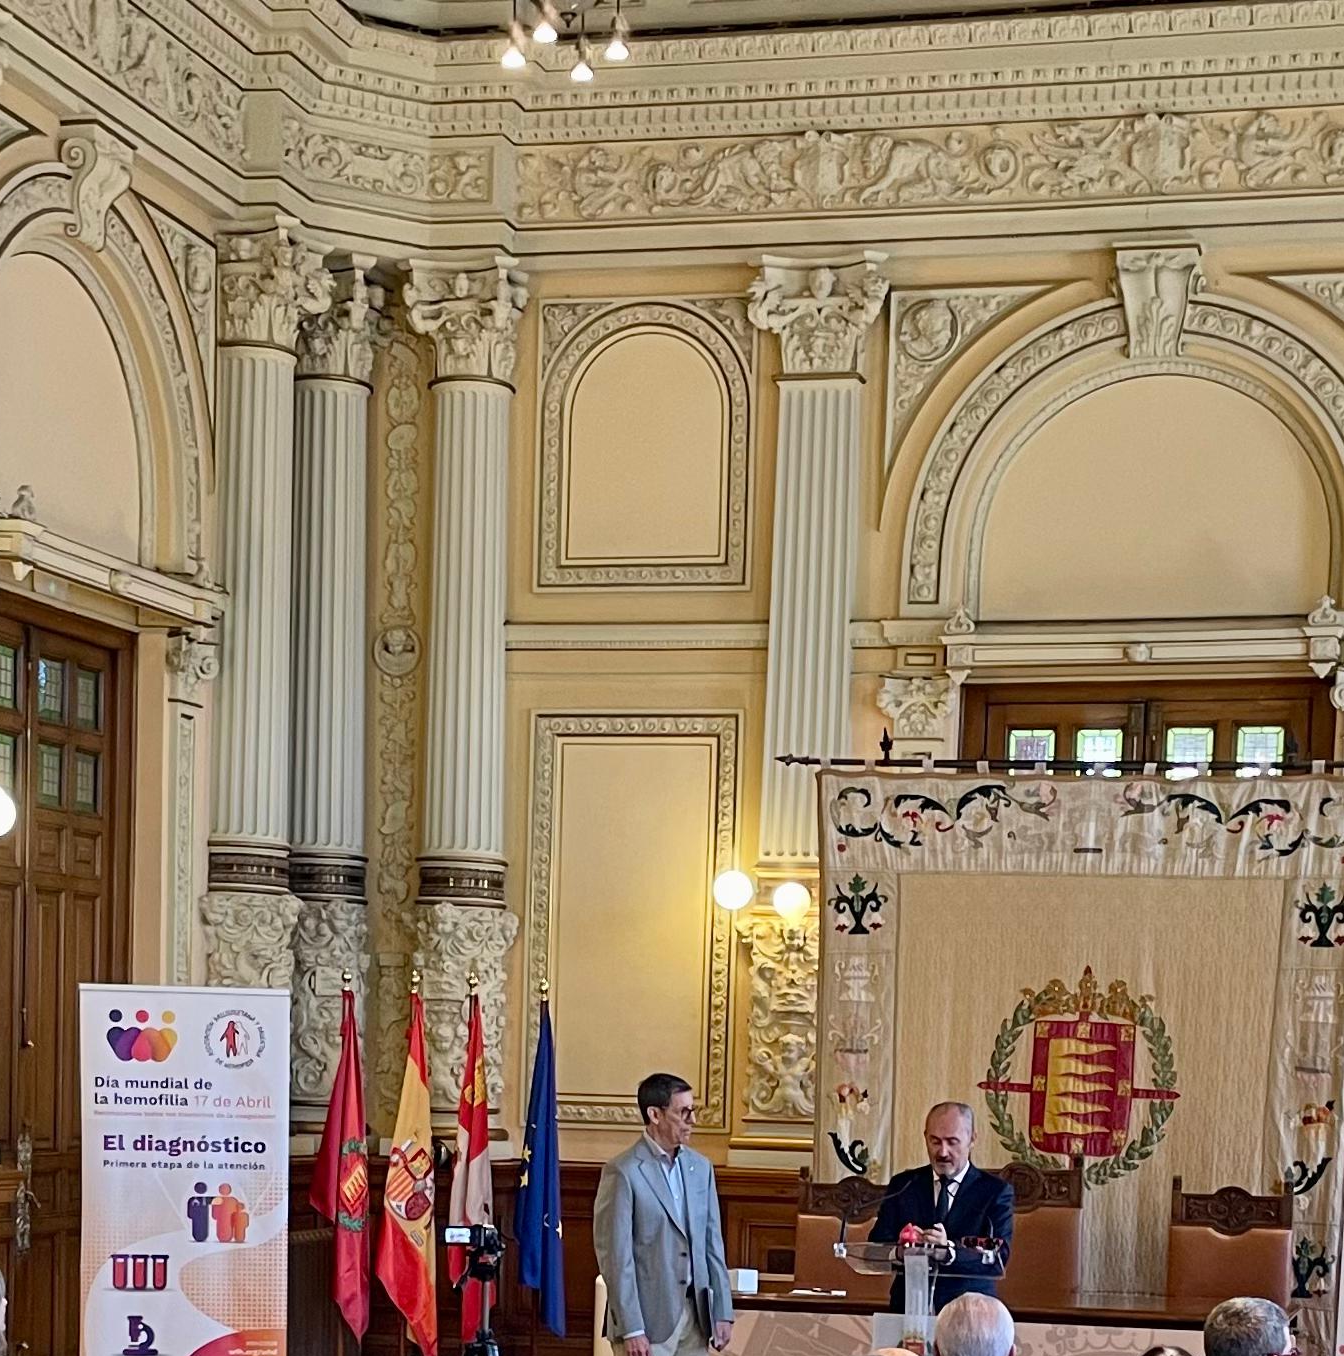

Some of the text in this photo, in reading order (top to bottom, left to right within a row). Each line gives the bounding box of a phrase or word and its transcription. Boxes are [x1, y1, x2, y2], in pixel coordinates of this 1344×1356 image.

[94, 1076, 213, 1091] Día mundial de
[94, 1092, 272, 1109] la hemofilia 17 de Abril
[103, 1134, 267, 1157] El diagnóstico
[103, 1159, 266, 1171] Primera etapa de la atención
